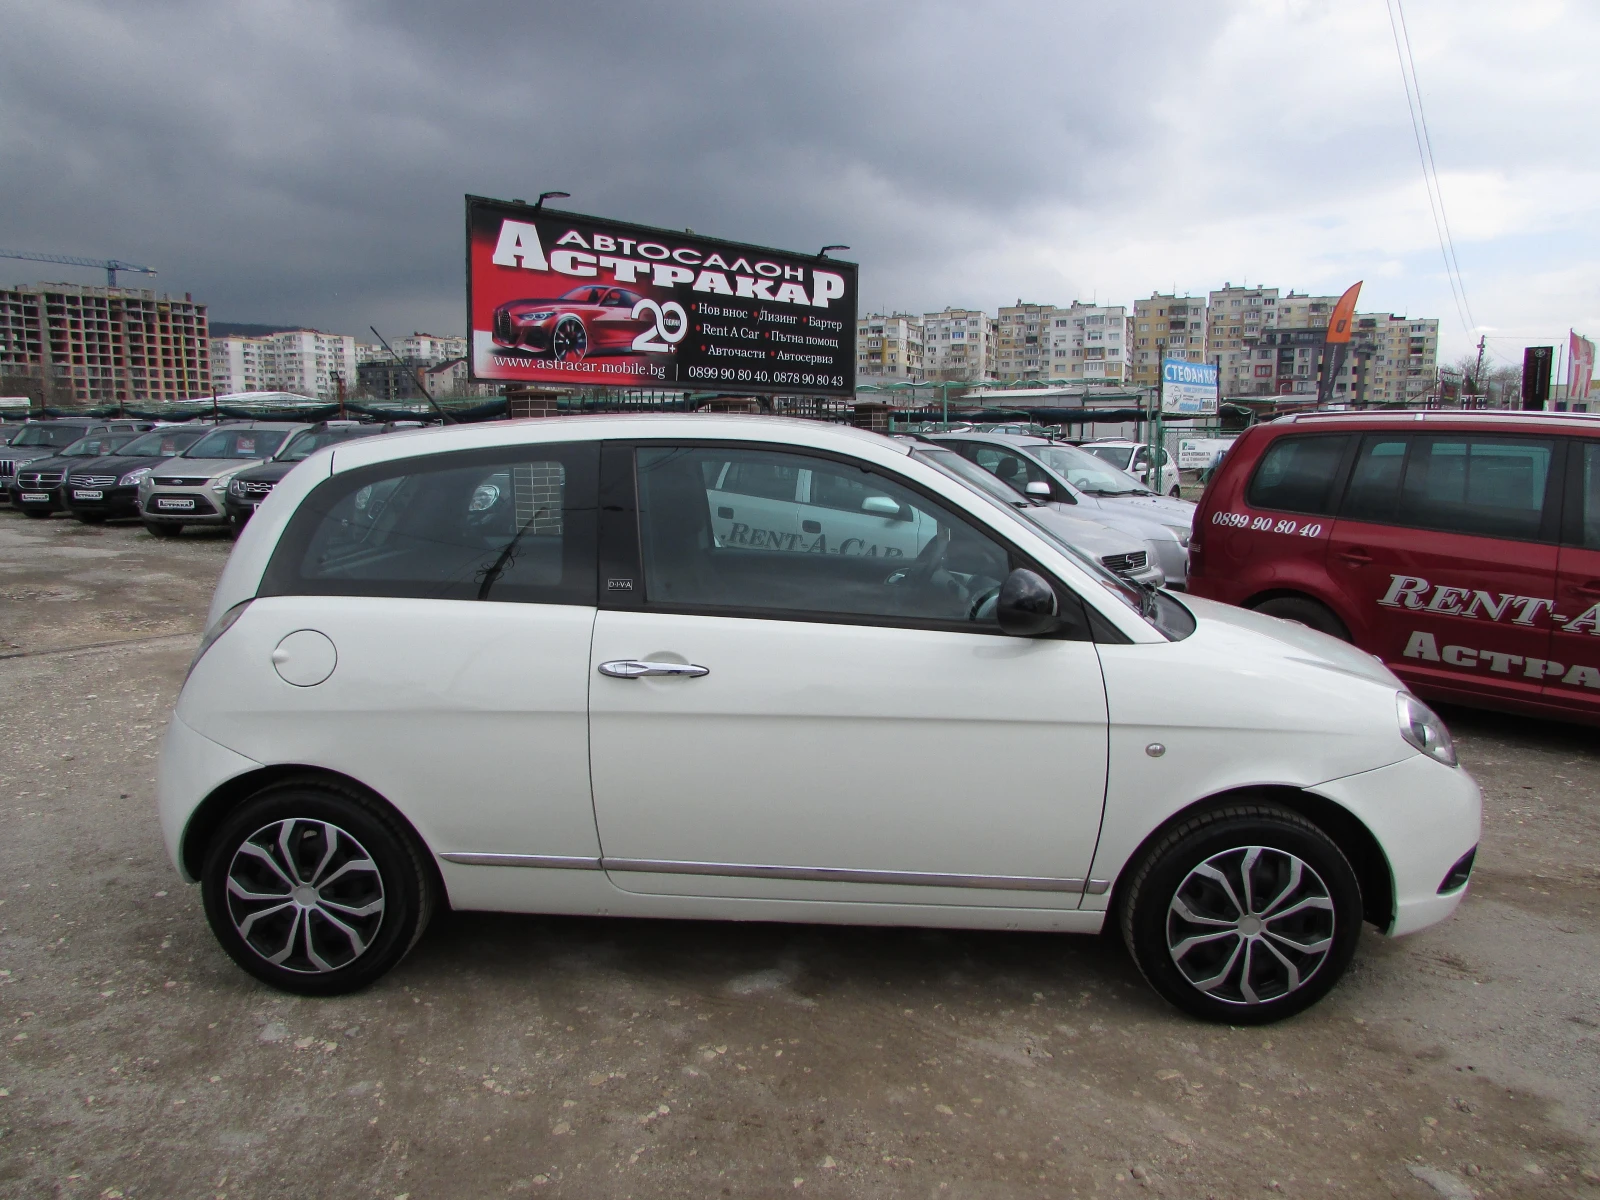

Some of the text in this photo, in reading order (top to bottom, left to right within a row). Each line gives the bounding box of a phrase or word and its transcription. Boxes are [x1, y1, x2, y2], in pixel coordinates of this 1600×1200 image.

[493, 219, 845, 308] АСТРАКАР
[556, 231, 804, 281] АВТОСАЛОН
[699, 303, 748, 319] Нов внос
[759, 310, 798, 324] Лизинг
[702, 324, 760, 340] Rent A Car
[808, 316, 843, 332] Бартер
[771, 331, 839, 349] Пътна помощ
[708, 344, 766, 359] Авточасти
[776, 350, 834, 365] Автосервиз
[493, 356, 666, 380] www.astracar.mobile.bg
[688, 366, 844, 387] 0899 90 80 40, 0878 90 80 43
[1212, 511, 1321, 538] 0899 90 80 40
